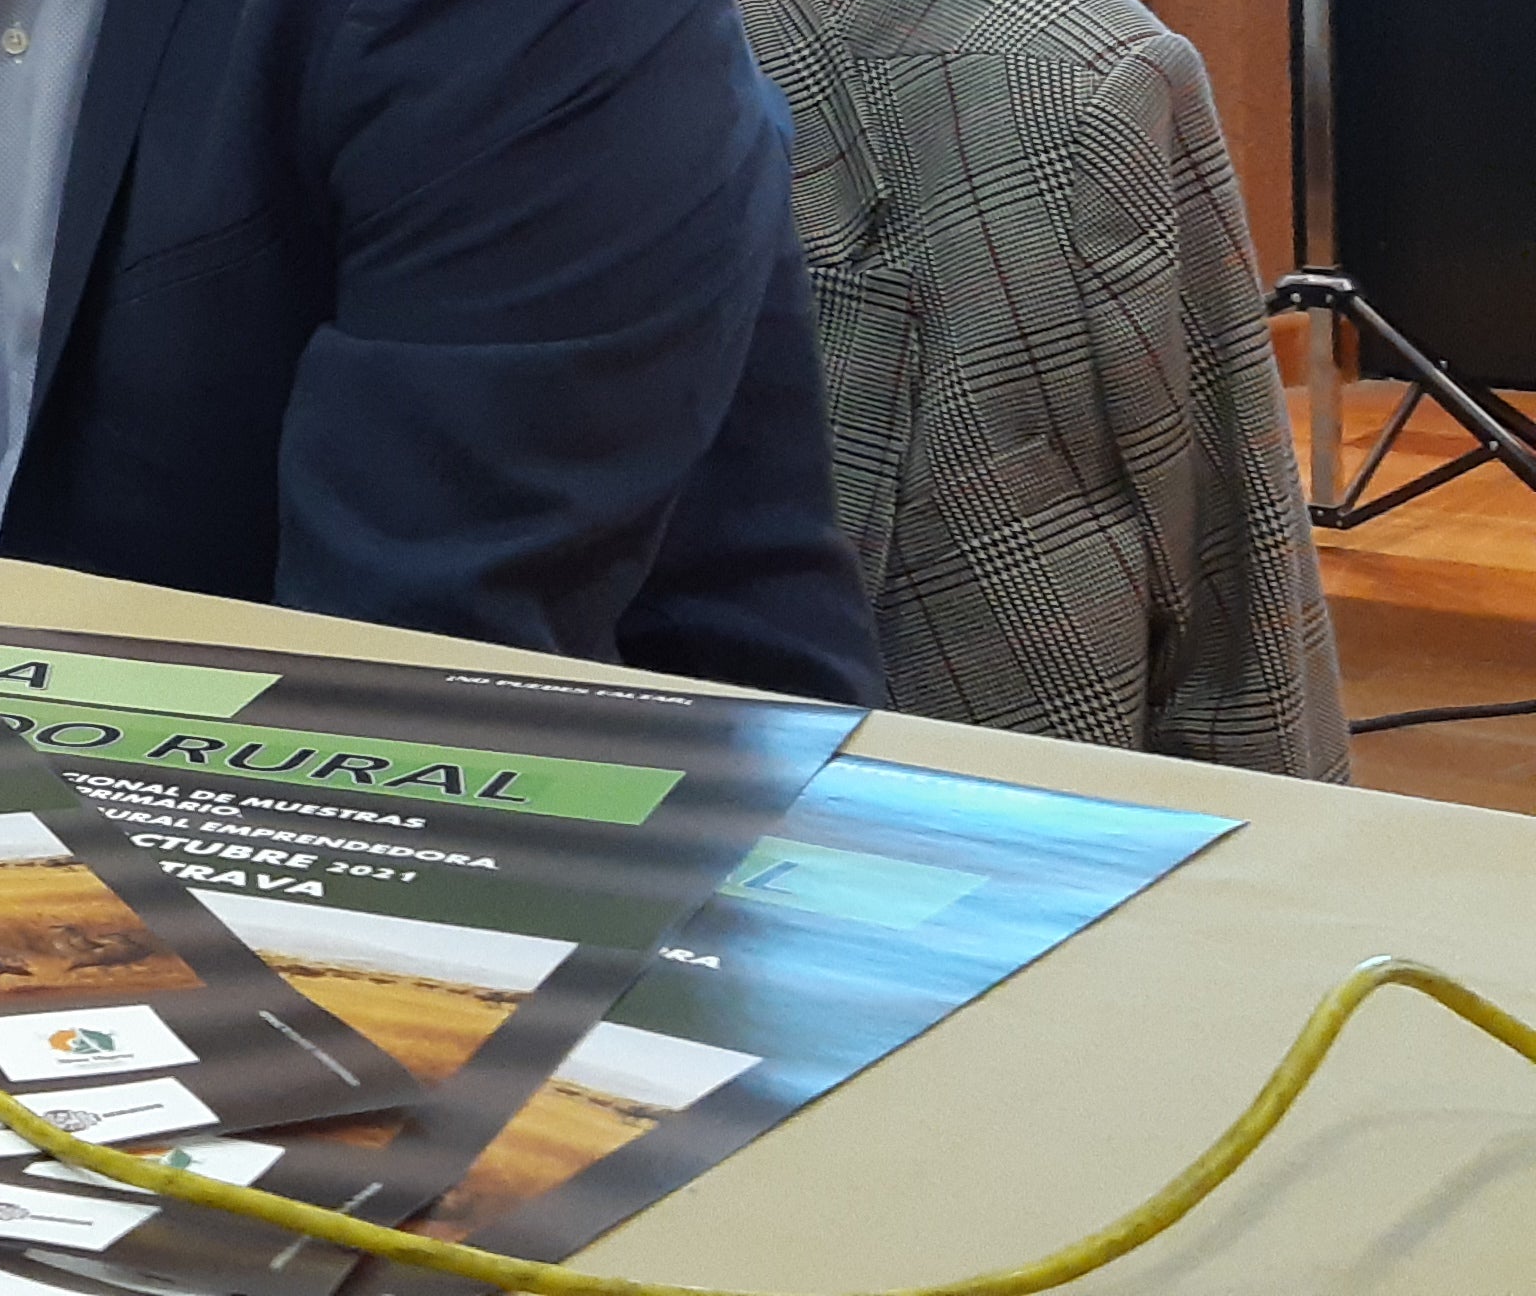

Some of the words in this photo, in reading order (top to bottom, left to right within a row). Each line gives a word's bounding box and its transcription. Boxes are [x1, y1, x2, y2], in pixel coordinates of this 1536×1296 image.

[145, 734, 531, 805] RURAL
[97, 806, 190, 829] URAL
[200, 821, 500, 871] EMPRENDEDORA
[188, 789, 237, 804] DE
[240, 796, 428, 830] MUESTRAS
[125, 831, 319, 870] CTUBRE
[326, 861, 417, 883] 2021
